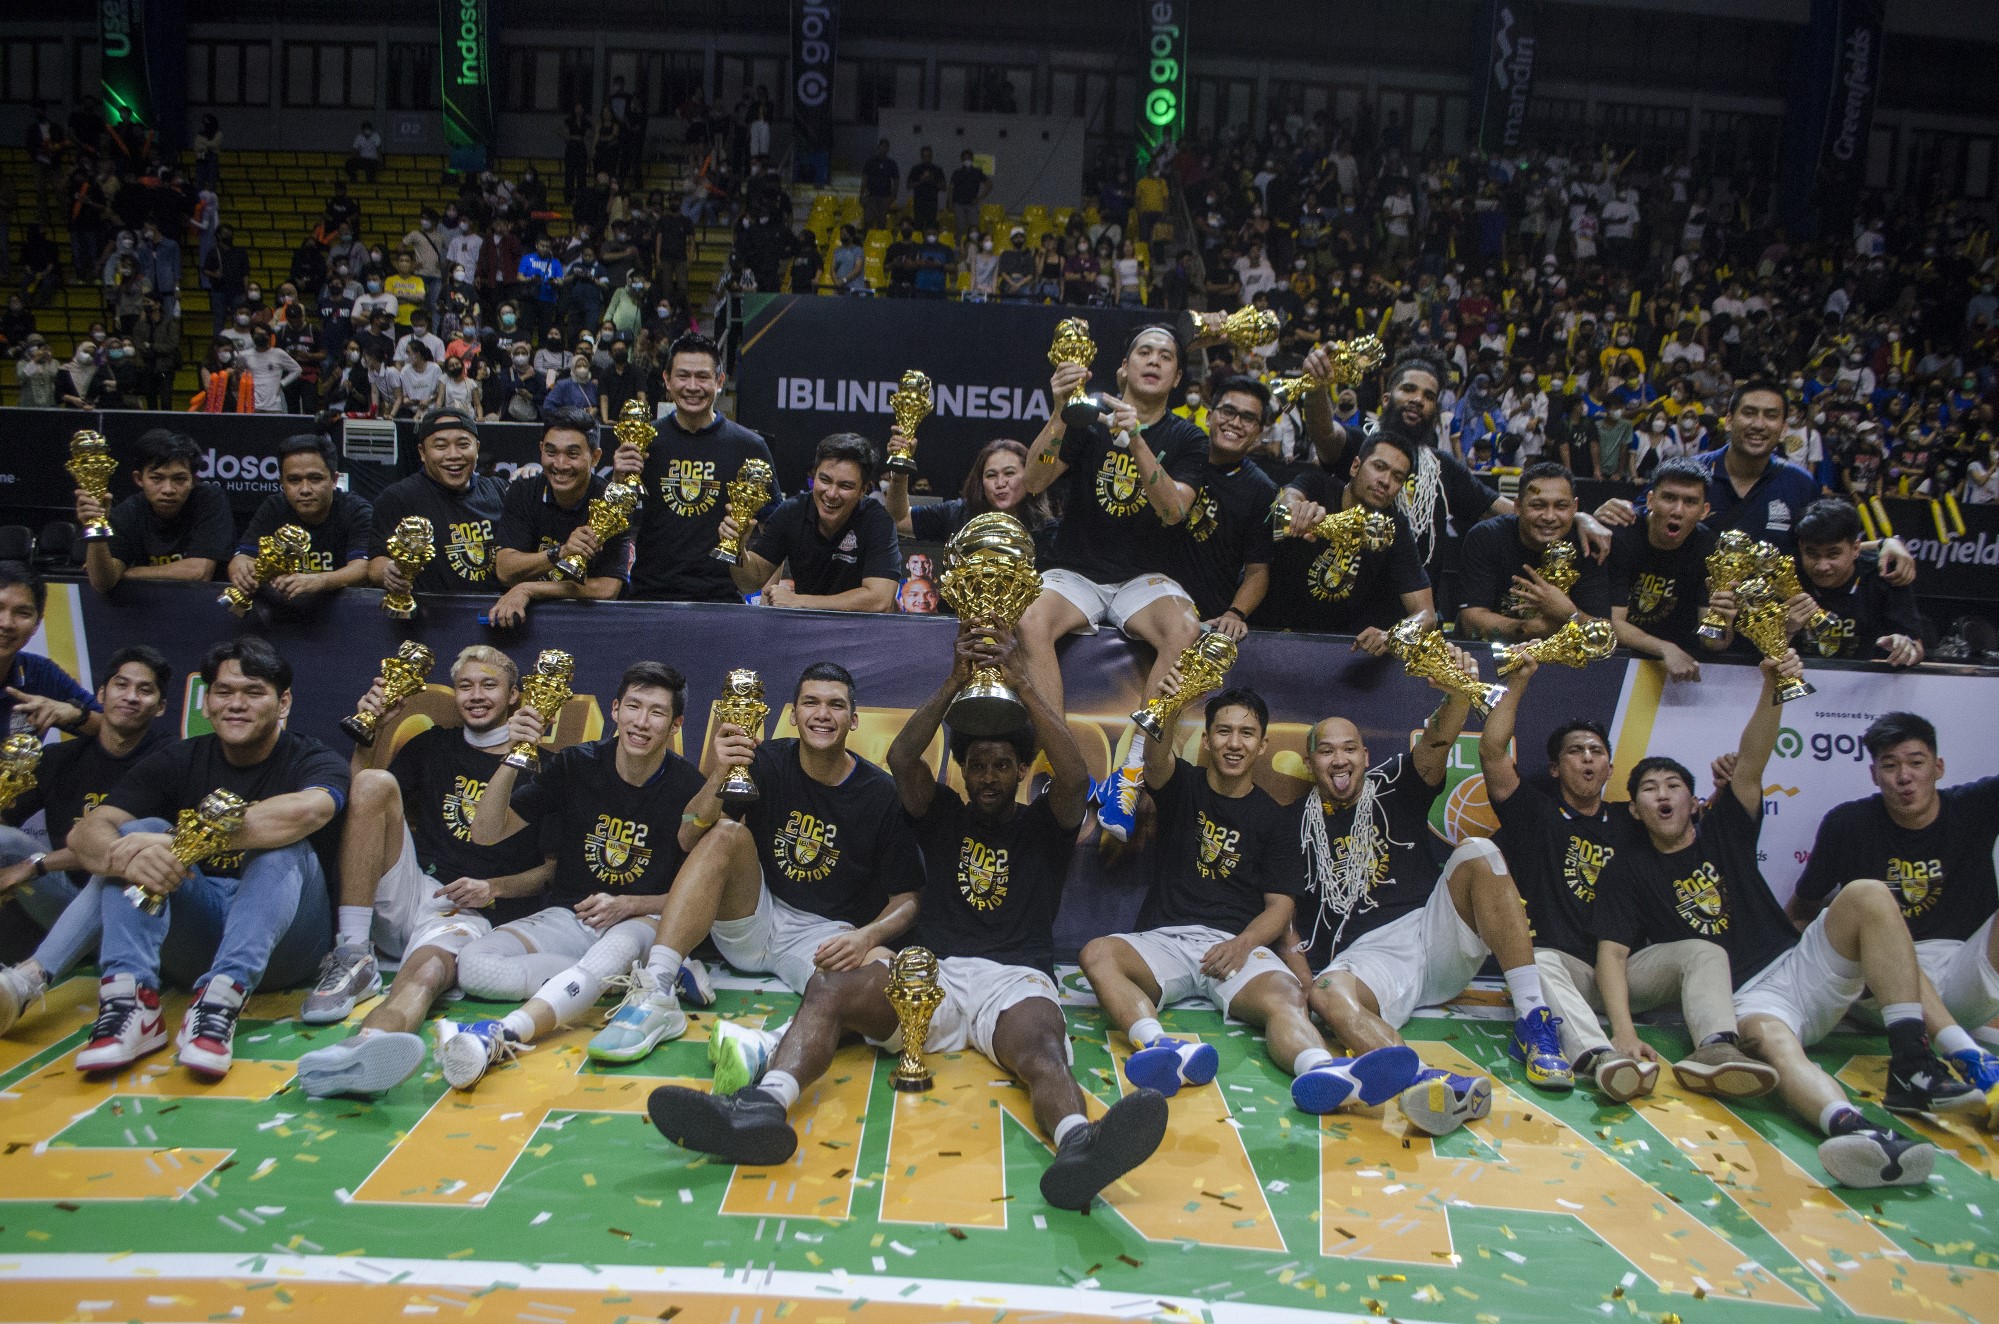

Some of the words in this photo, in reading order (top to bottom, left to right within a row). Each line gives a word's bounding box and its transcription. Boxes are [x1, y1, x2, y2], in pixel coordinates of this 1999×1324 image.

[777, 373, 1050, 421] IBLINDNESIA
[668, 459, 716, 480] 2022
[1102, 451, 1141, 479] 202
[661, 485, 719, 517] CHAMPIONS
[449, 519, 494, 543] 2022
[301, 551, 333, 571] 022
[595, 814, 649, 847] 2022
[785, 811, 838, 848] 2022
[1197, 811, 1241, 853] 2022
[584, 843, 650, 886] CHAMPIONS
[774, 838, 837, 882] CHAMPIONS
[959, 837, 1009, 873] 2022
[1887, 857, 1943, 881] 2022
[1672, 861, 1720, 903] 2022
